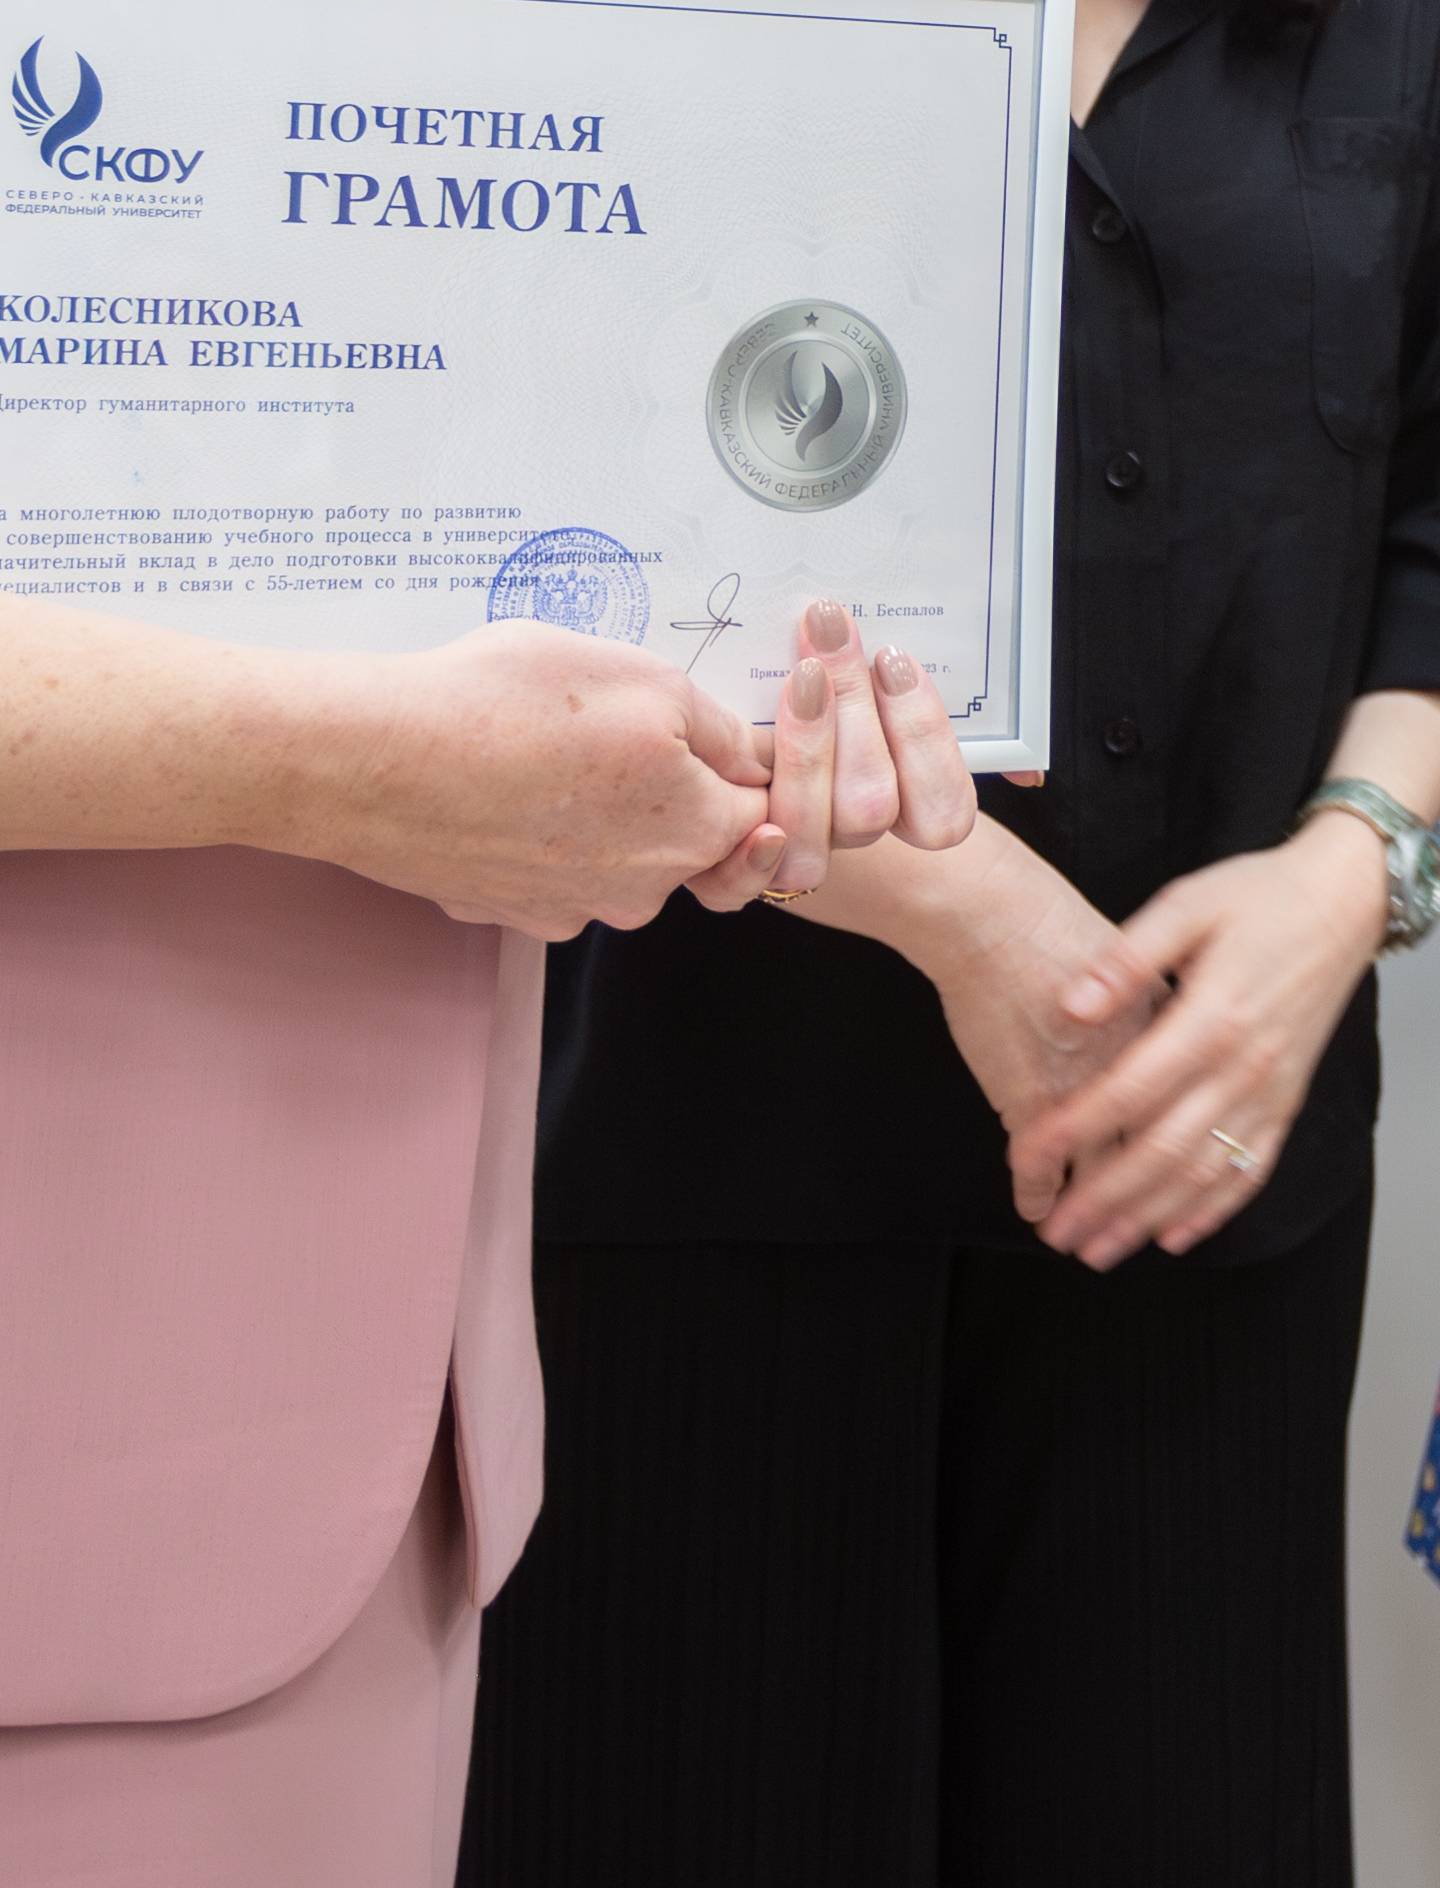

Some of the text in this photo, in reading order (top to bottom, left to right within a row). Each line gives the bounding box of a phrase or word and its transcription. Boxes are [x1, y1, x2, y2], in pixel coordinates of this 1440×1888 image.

[286, 102, 604, 152] ПОЧЕТНАЯ
[56, 142, 203, 183] СКФУ
[5, 204, 202, 219] ФЕДЕРАЛЬНЫЙ УНИВЕРСИТЕТ
[282, 172, 647, 234] ГРАМОТА
[190, 341, 446, 369] ЕВГЕНЬЕВНА
[99, 397, 246, 415] гуманитарного
[258, 399, 355, 416] института
[20, 507, 160, 521] многолетнюю
[173, 506, 314, 523] плодотворную
[326, 505, 389, 521] работу
[401, 507, 422, 519] по
[434, 506, 521, 521] развитию
[7, 531, 212, 547] совершенствованию
[224, 529, 314, 547] учебного
[326, 530, 411, 544] процесса
[423, 530, 433, 542] в
[139, 556, 195, 570] вклад
[209, 556, 217, 568] в
[228, 555, 274, 569] дело
[287, 554, 396, 569] подготовки
[134, 580, 144, 592] и
[158, 580, 167, 592] в
[180, 579, 233, 592] связи
[245, 579, 255, 591] с
[267, 576, 361, 591] 55-летием
[375, 577, 394, 590] со
[406, 576, 437, 591] дня
[877, 603, 944, 617] Беспалов
[750, 668, 791, 680] Прика
